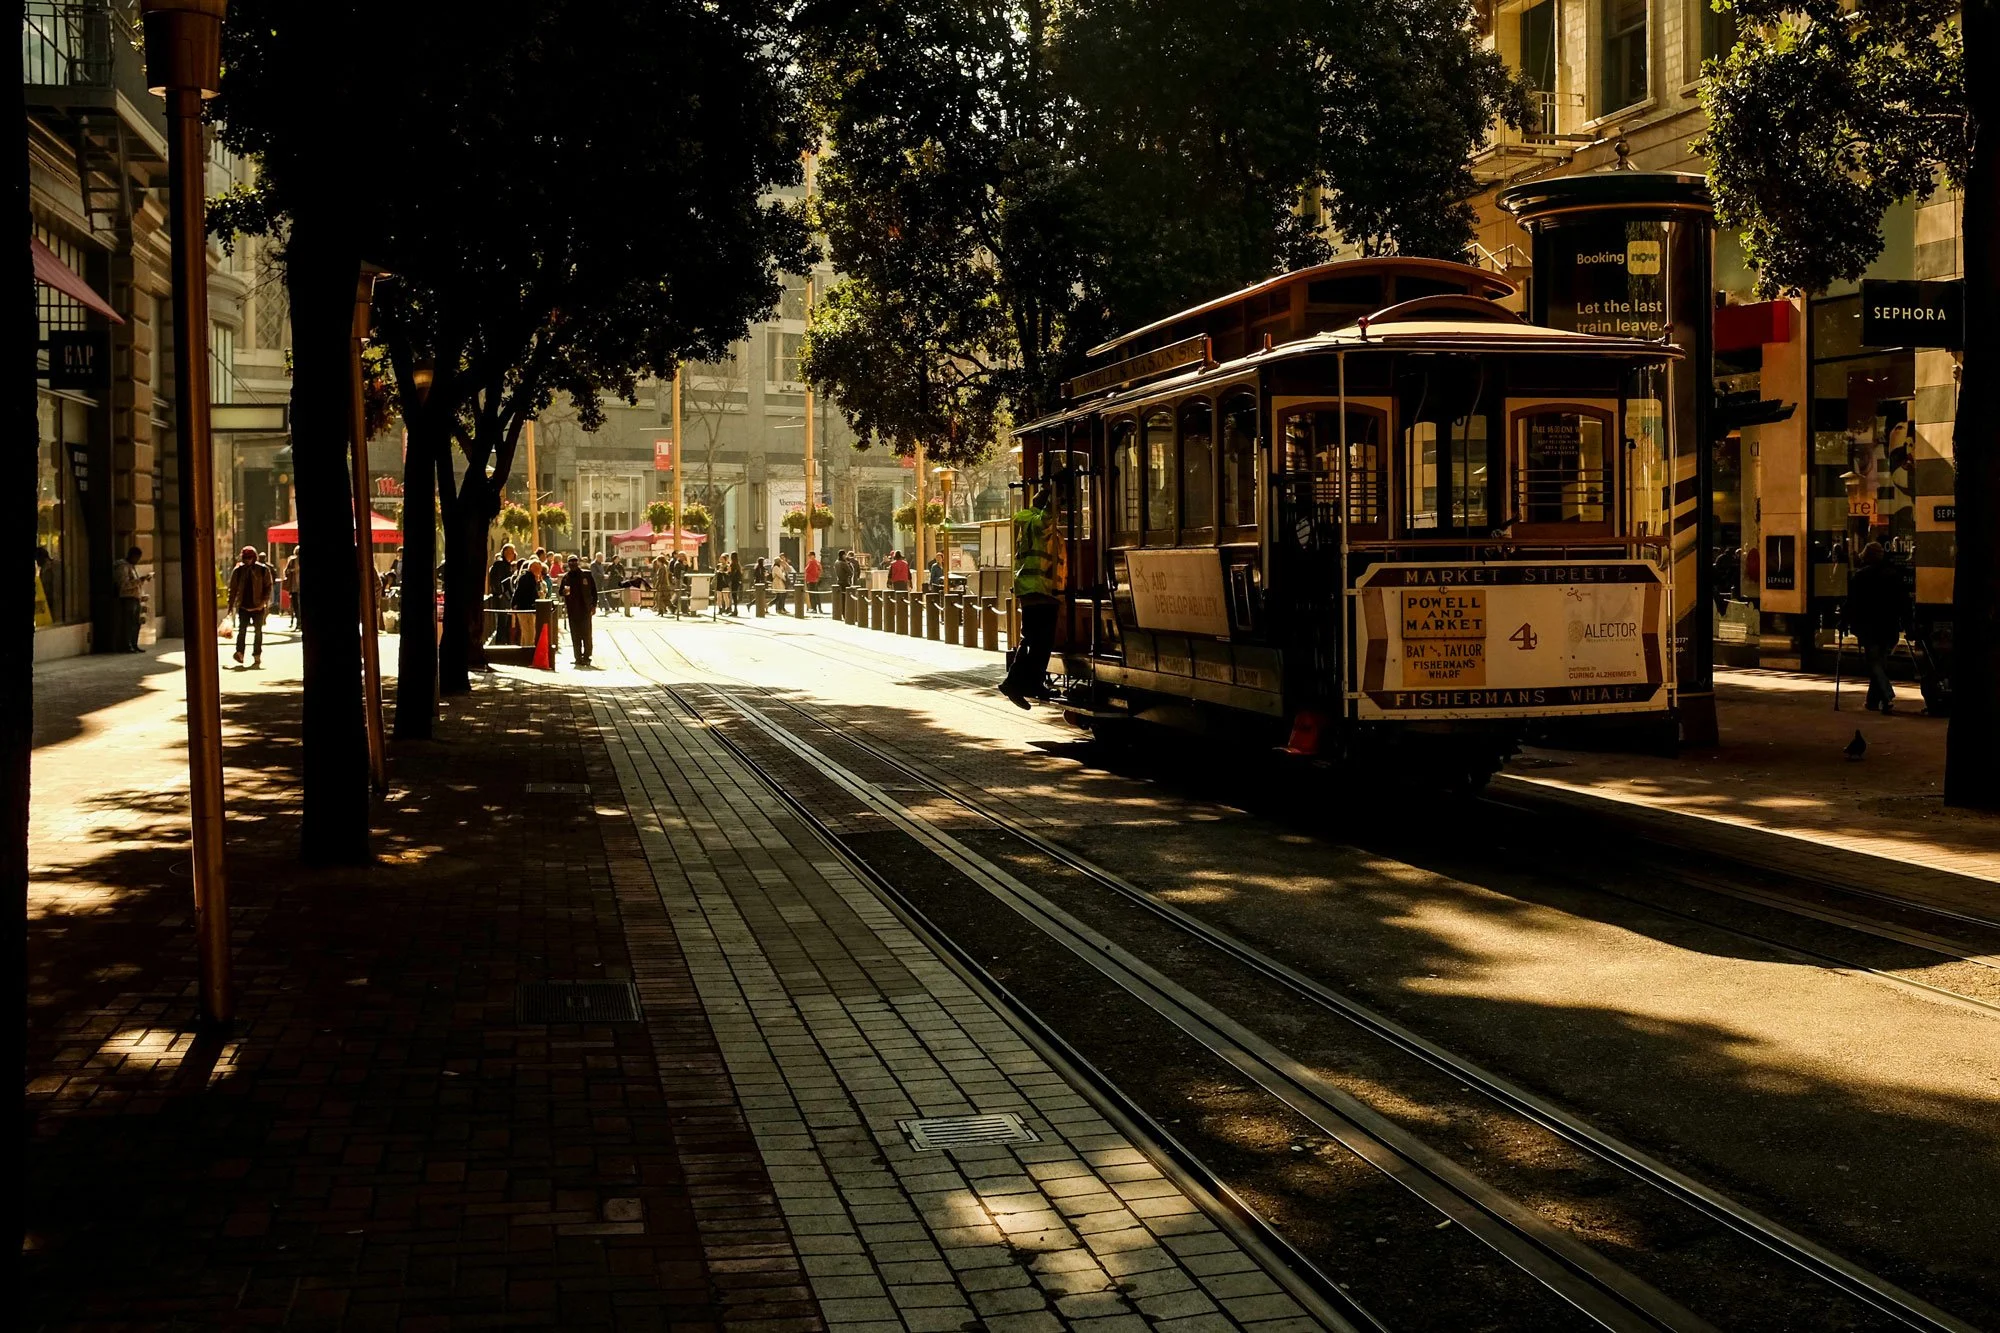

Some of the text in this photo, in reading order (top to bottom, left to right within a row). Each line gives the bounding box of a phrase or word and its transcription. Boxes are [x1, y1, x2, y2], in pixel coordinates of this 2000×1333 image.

[1577, 252, 1657, 265] Booking now
[1577, 299, 1662, 314] Let the last
[1874, 306, 1946, 321] SEPHORA
[1577, 318, 1662, 333] train leave.
[64, 344, 94, 366] GAP
[1131, 350, 1175, 374] MASON
[1152, 571, 1167, 591] AND
[1405, 569, 1500, 583] MARKET
[1524, 567, 1608, 582] STREET
[1407, 597, 1481, 609] POWELL
[1427, 609, 1464, 618] AND
[1406, 619, 1482, 631] MARKET
[1509, 622, 1637, 650] 4 ALECTOR
[1406, 645, 1425, 658] BAY
[1444, 643, 1482, 657] TAYLOR
[1413, 660, 1475, 670] FISHERMAN'S
[1429, 669, 1461, 679] WHARF
[1395, 687, 1638, 706] FISHERMANS WHARF
